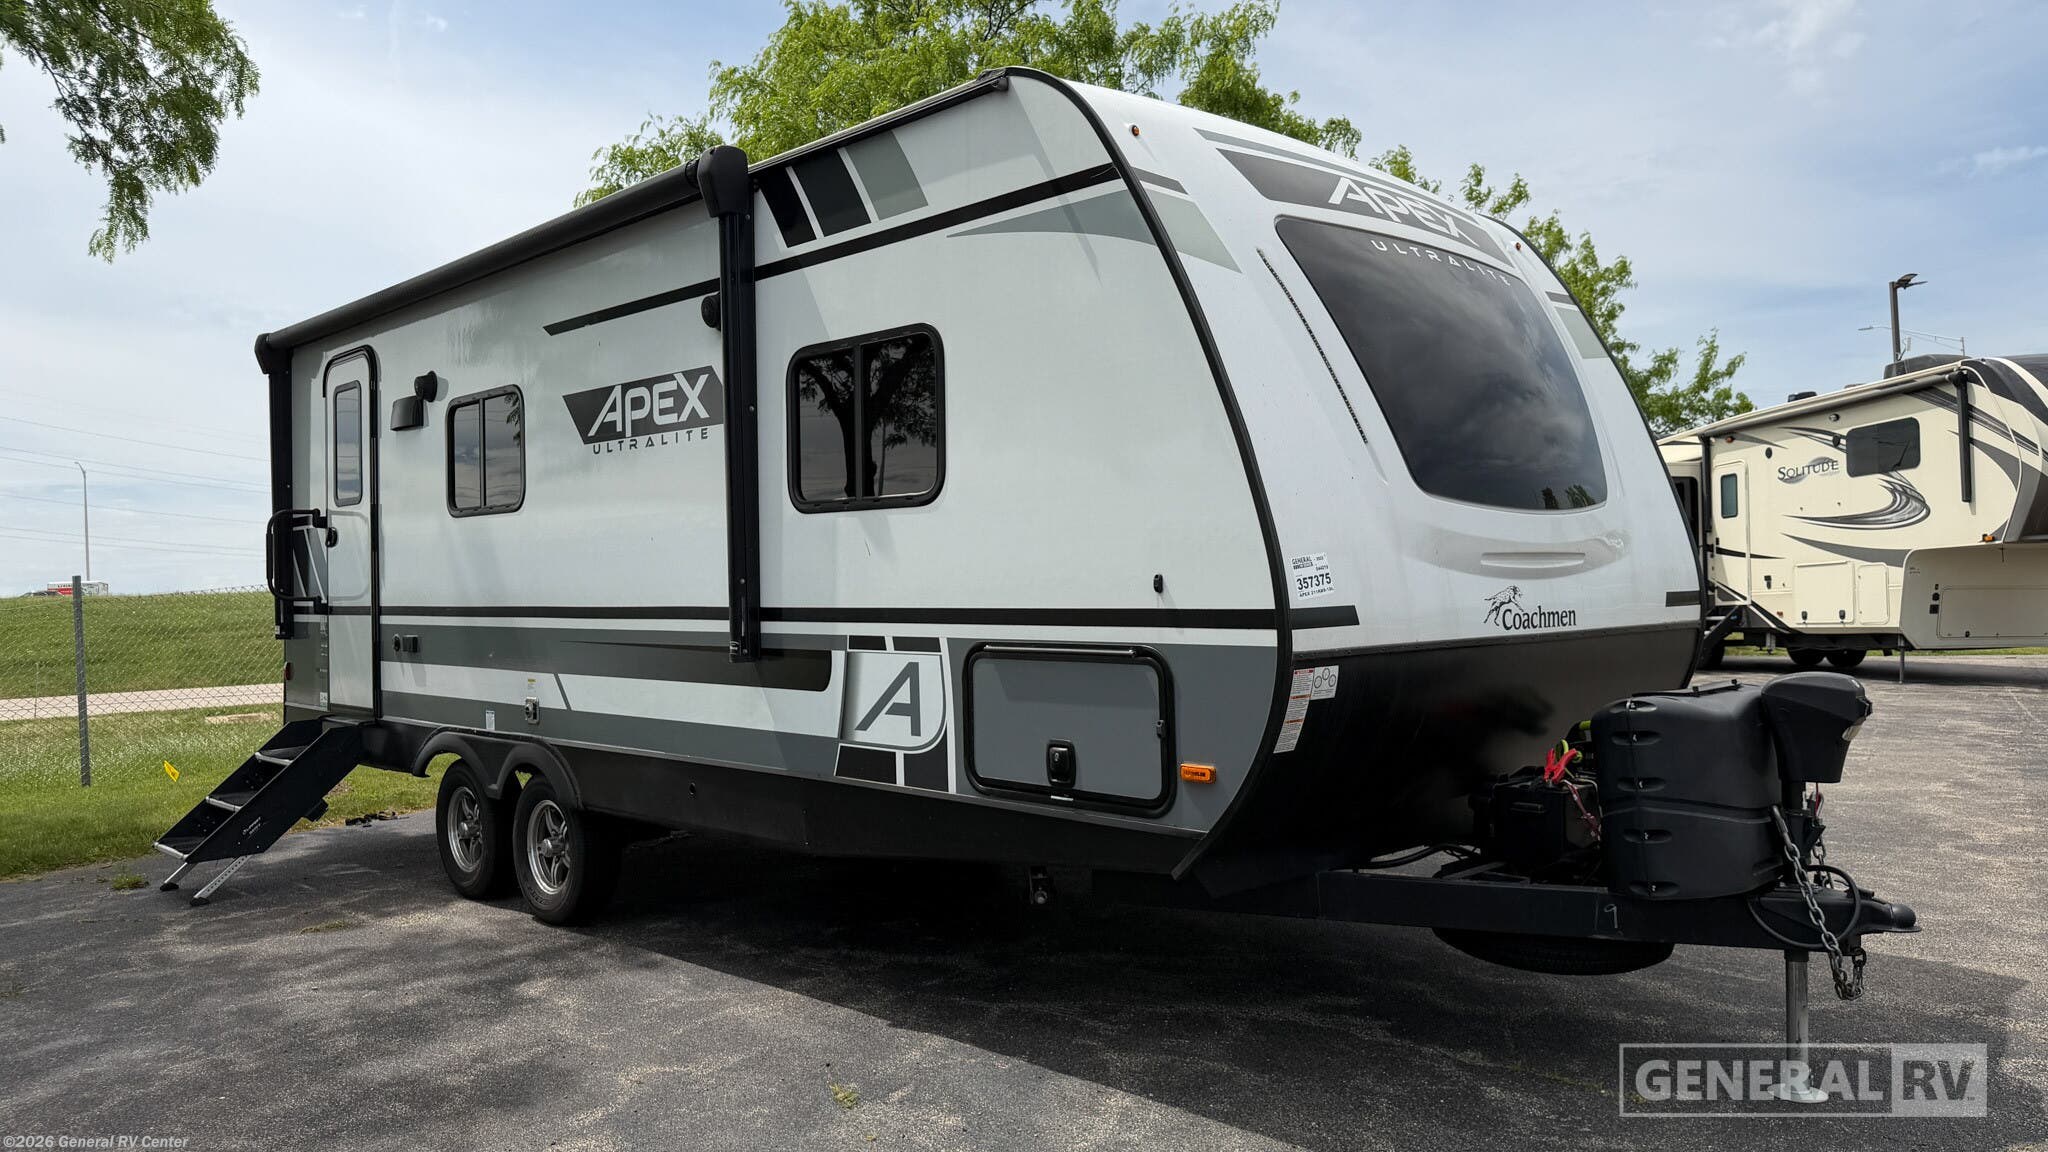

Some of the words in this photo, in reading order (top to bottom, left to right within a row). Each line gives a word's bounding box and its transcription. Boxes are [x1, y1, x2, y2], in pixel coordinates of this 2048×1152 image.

[1328, 177, 1480, 247] APEX
[1371, 240, 1511, 287] ULTRALITE
[587, 372, 710, 438] APEX
[593, 427, 709, 455] ULTRALITE
[1296, 572, 1332, 591] 357375
[1502, 605, 1577, 631] Coachmen
[855, 662, 922, 737] A
